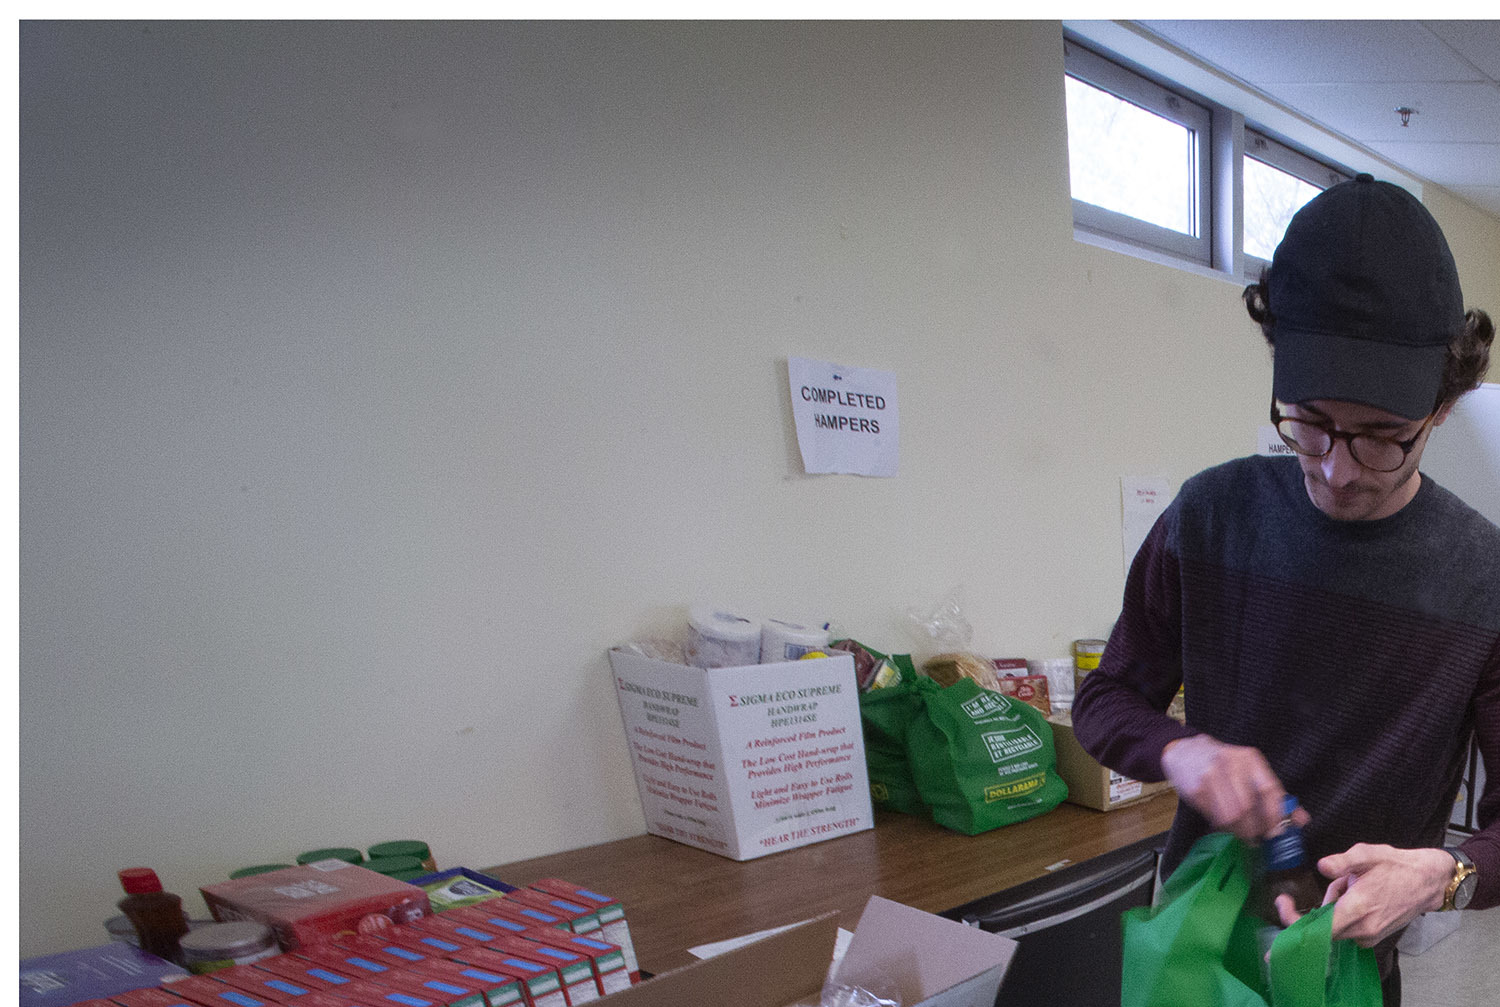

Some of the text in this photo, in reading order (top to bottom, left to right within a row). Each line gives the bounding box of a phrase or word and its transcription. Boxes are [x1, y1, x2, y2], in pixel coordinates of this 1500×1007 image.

[801, 386, 886, 410] COMPLETED
[813, 413, 880, 434] HAMPERS
[739, 694, 774, 707] SIGMA
[775, 690, 796, 701] ECO
[797, 684, 842, 699] SUPREME
[767, 702, 819, 717] HANDWRAP
[746, 726, 846, 750] A Reinforced Film Product
[741, 742, 854, 769] The Low Cost Hand-wrap that
[747, 753, 852, 779] Provides High Performance
[751, 772, 853, 801] Light and Easy to Use Rolls
[753, 783, 854, 810] Minimize Wrapper Fatigue
[989, 779, 1039, 799] DOLLARAMA
[791, 828, 810, 840] THE
